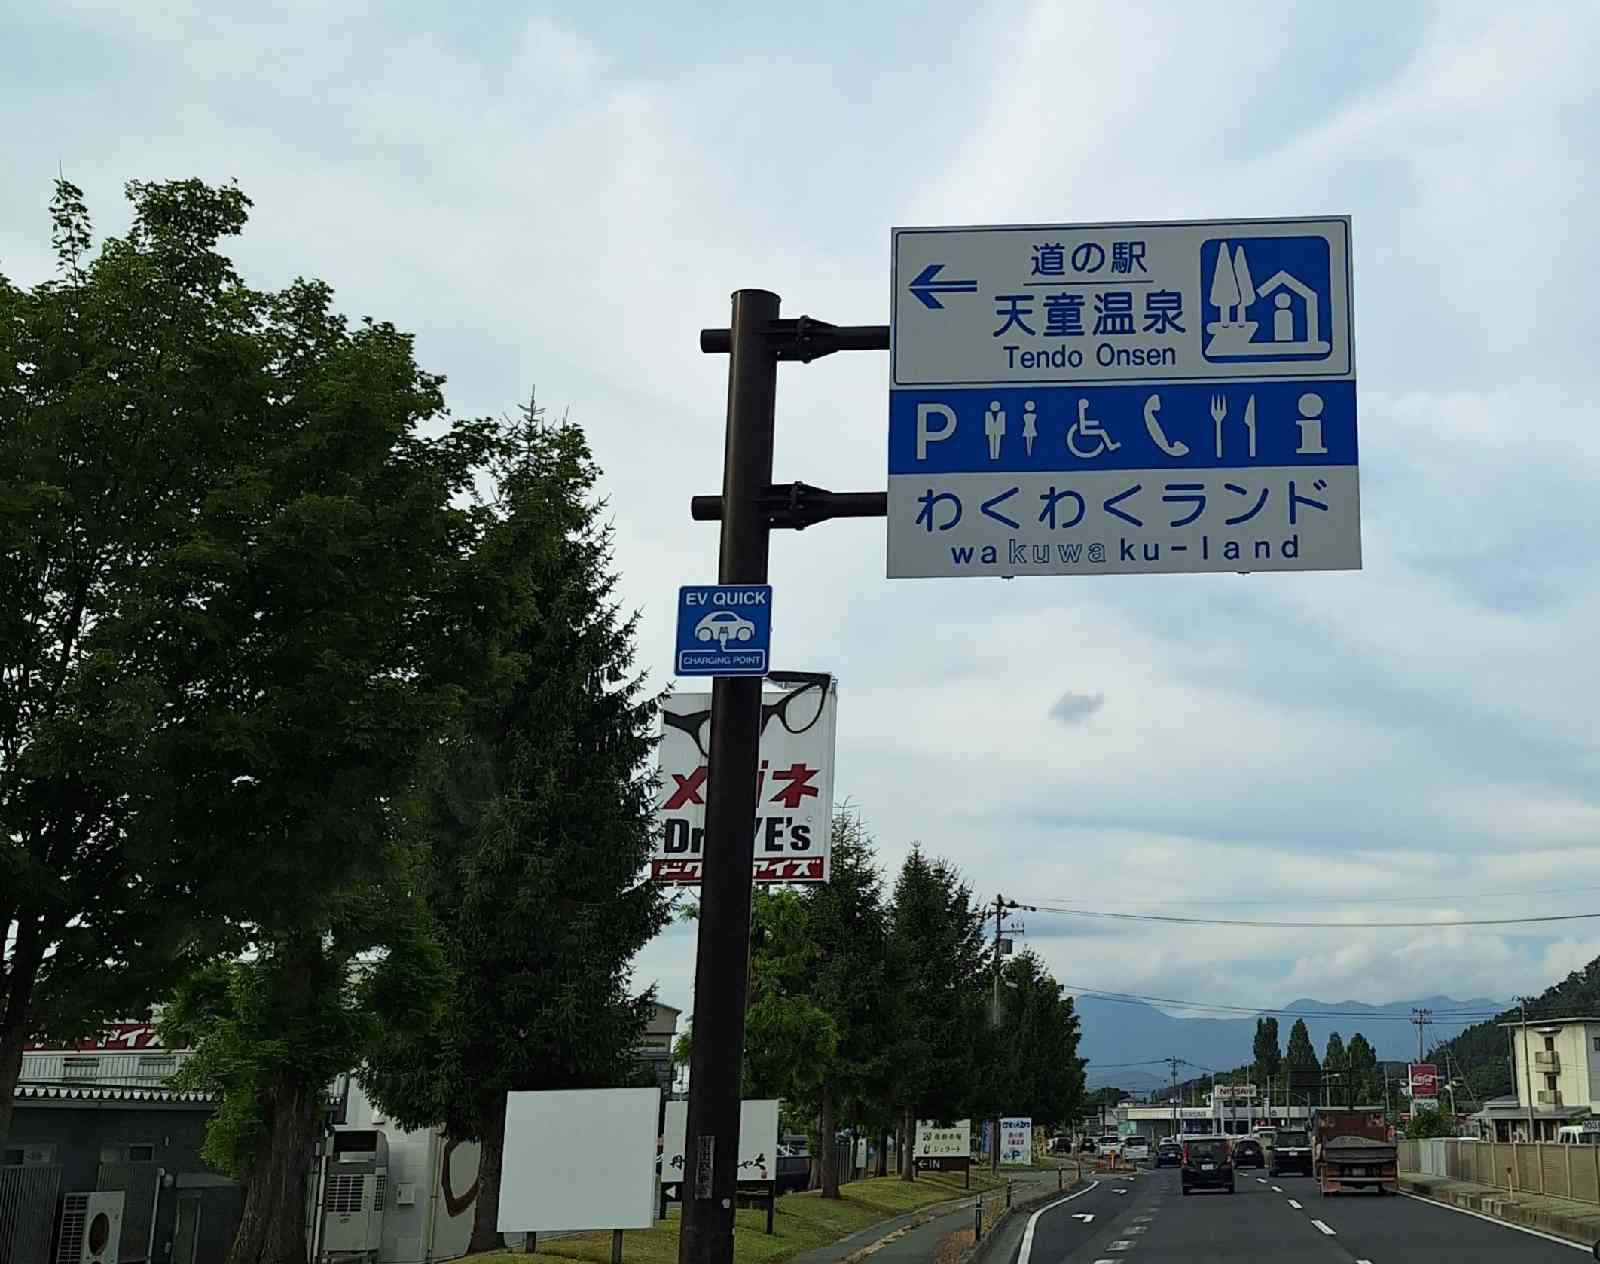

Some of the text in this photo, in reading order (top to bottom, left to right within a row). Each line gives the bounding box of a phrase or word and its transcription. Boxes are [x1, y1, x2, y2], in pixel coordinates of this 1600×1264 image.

[1030, 241, 1148, 276] 道の駅
[993, 290, 1187, 338] 天童温泉
[1003, 342, 1176, 369] Tendo Onsen
[915, 403, 958, 460] P
[914, 479, 1329, 533] わくわくランド
[686, 590, 767, 606] EV QUICK
[683, 655, 762, 666] CHARGING POINT
[661, 760, 820, 810] メネ
